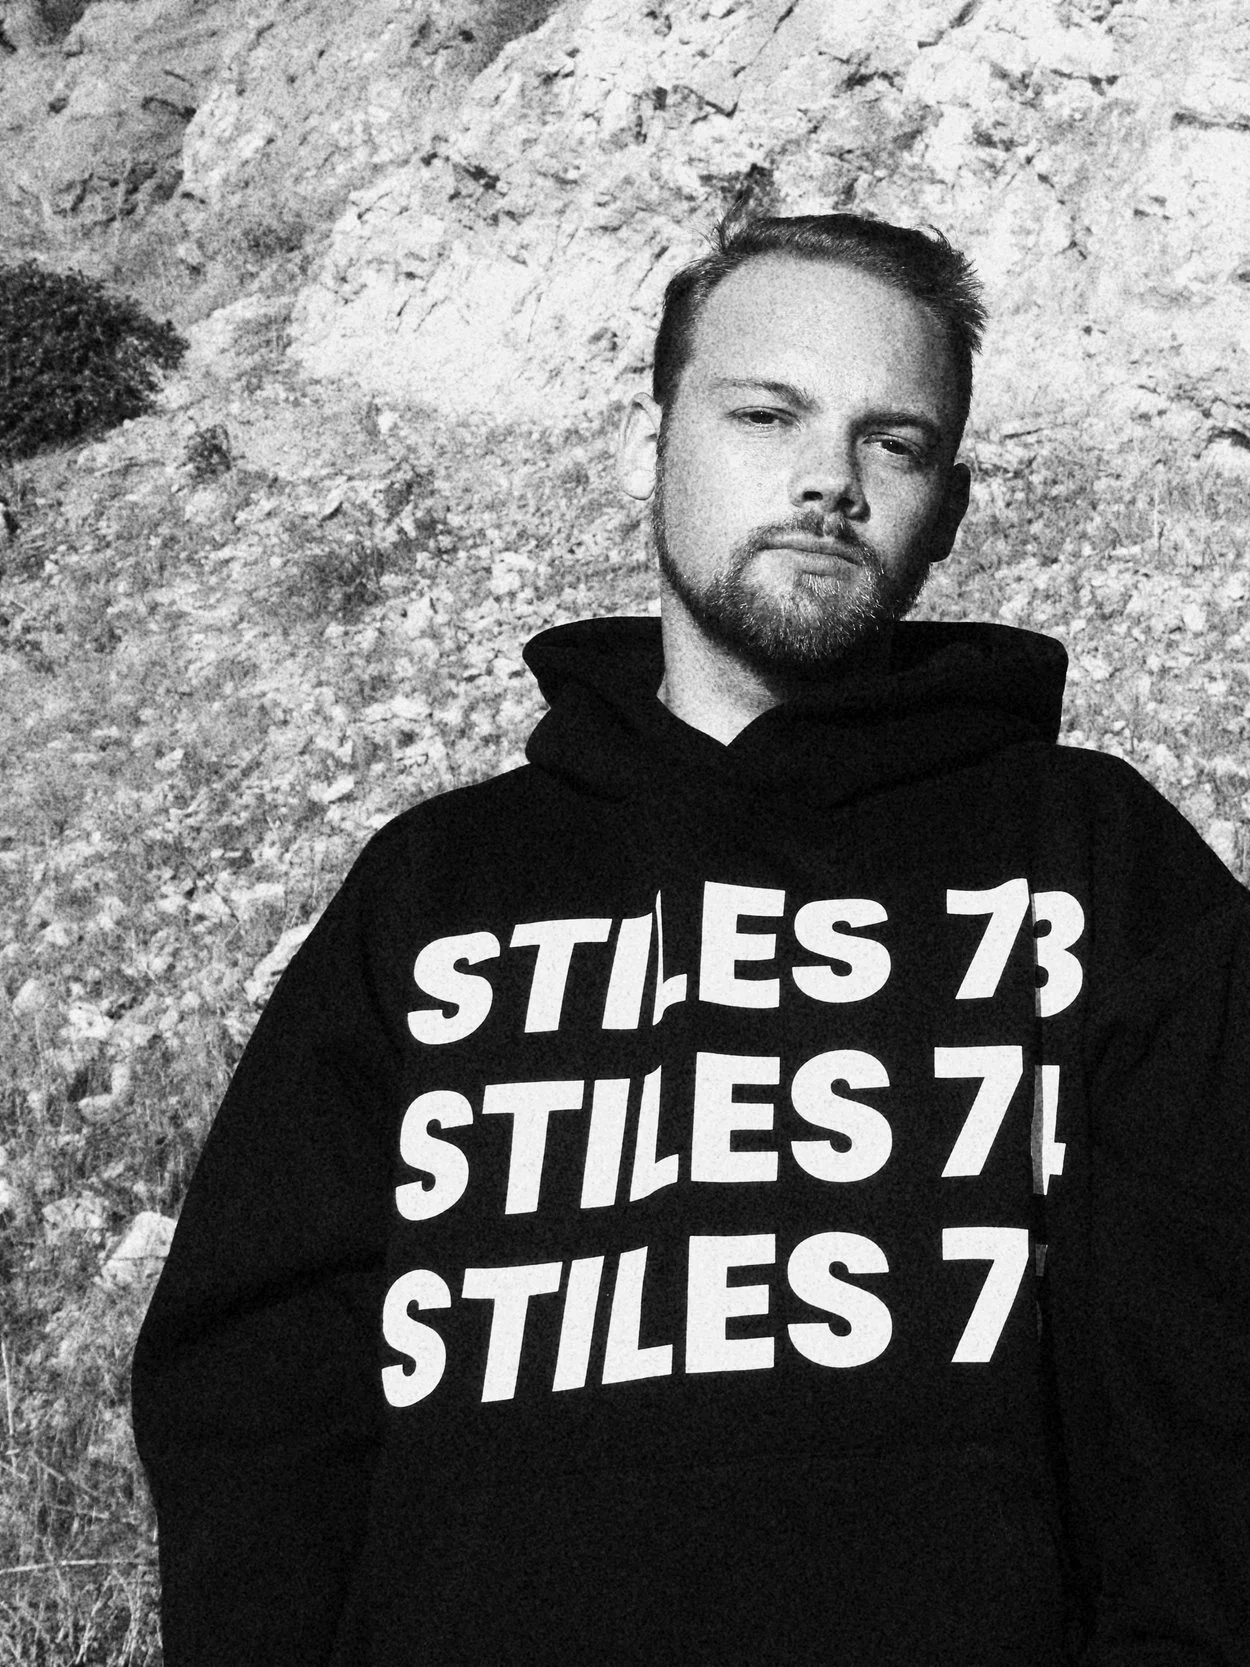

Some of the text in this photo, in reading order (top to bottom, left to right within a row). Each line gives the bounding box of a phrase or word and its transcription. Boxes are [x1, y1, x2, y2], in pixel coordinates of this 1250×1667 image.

[407, 878, 1085, 1045] STILES 73
[395, 1049, 893, 1221] STILES
[381, 1227, 1048, 1408] STILES 7
